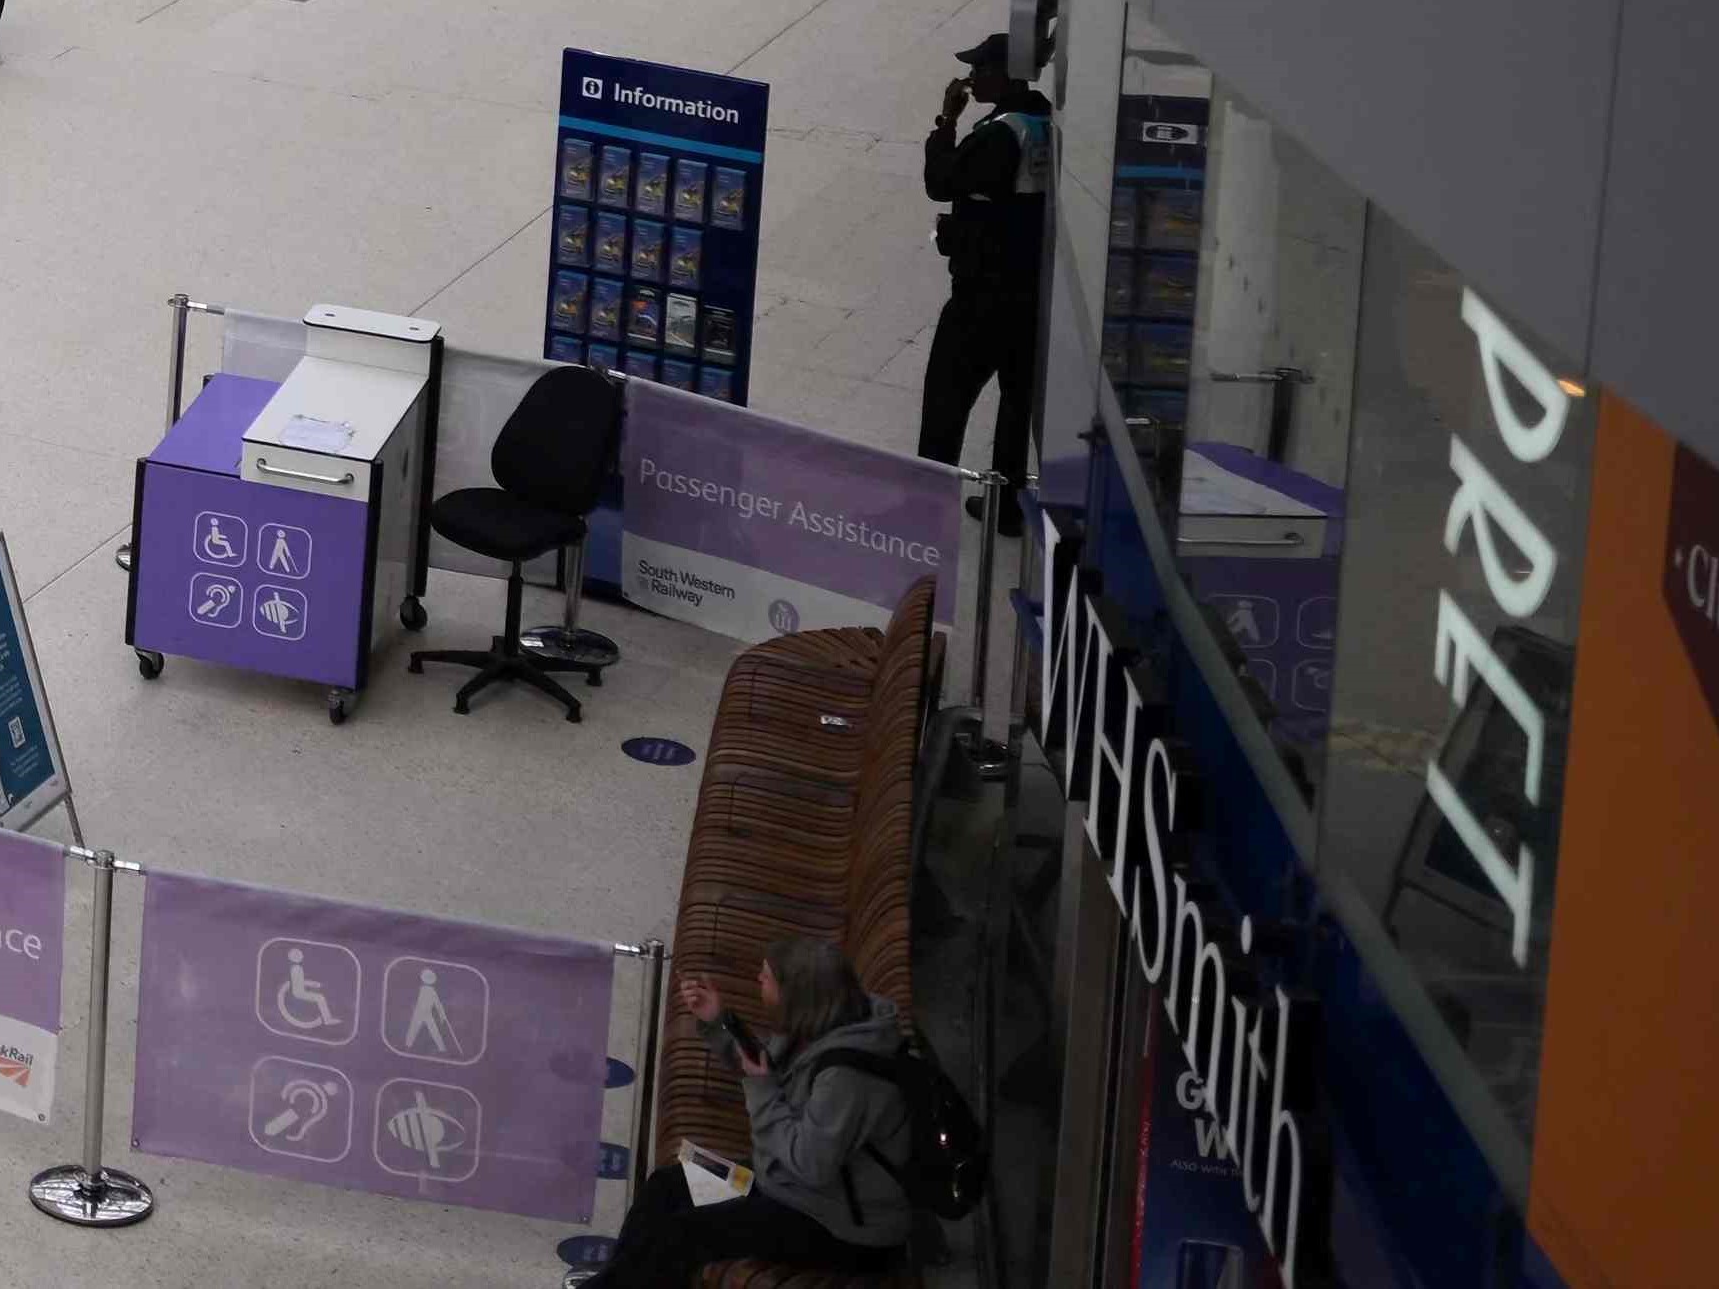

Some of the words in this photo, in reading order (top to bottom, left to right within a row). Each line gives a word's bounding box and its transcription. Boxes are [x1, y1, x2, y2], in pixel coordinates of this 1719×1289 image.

[612, 82, 741, 125] Information
[640, 457, 782, 519] Passenger
[788, 501, 942, 567] Assistance
[638, 559, 678, 584] South
[679, 569, 736, 600] Western
[650, 579, 703, 607] Railway
[1430, 286, 1571, 970] PRET
[1040, 506, 1303, 1289] WHSmith
[1170, 1158, 1198, 1173] ALSO
